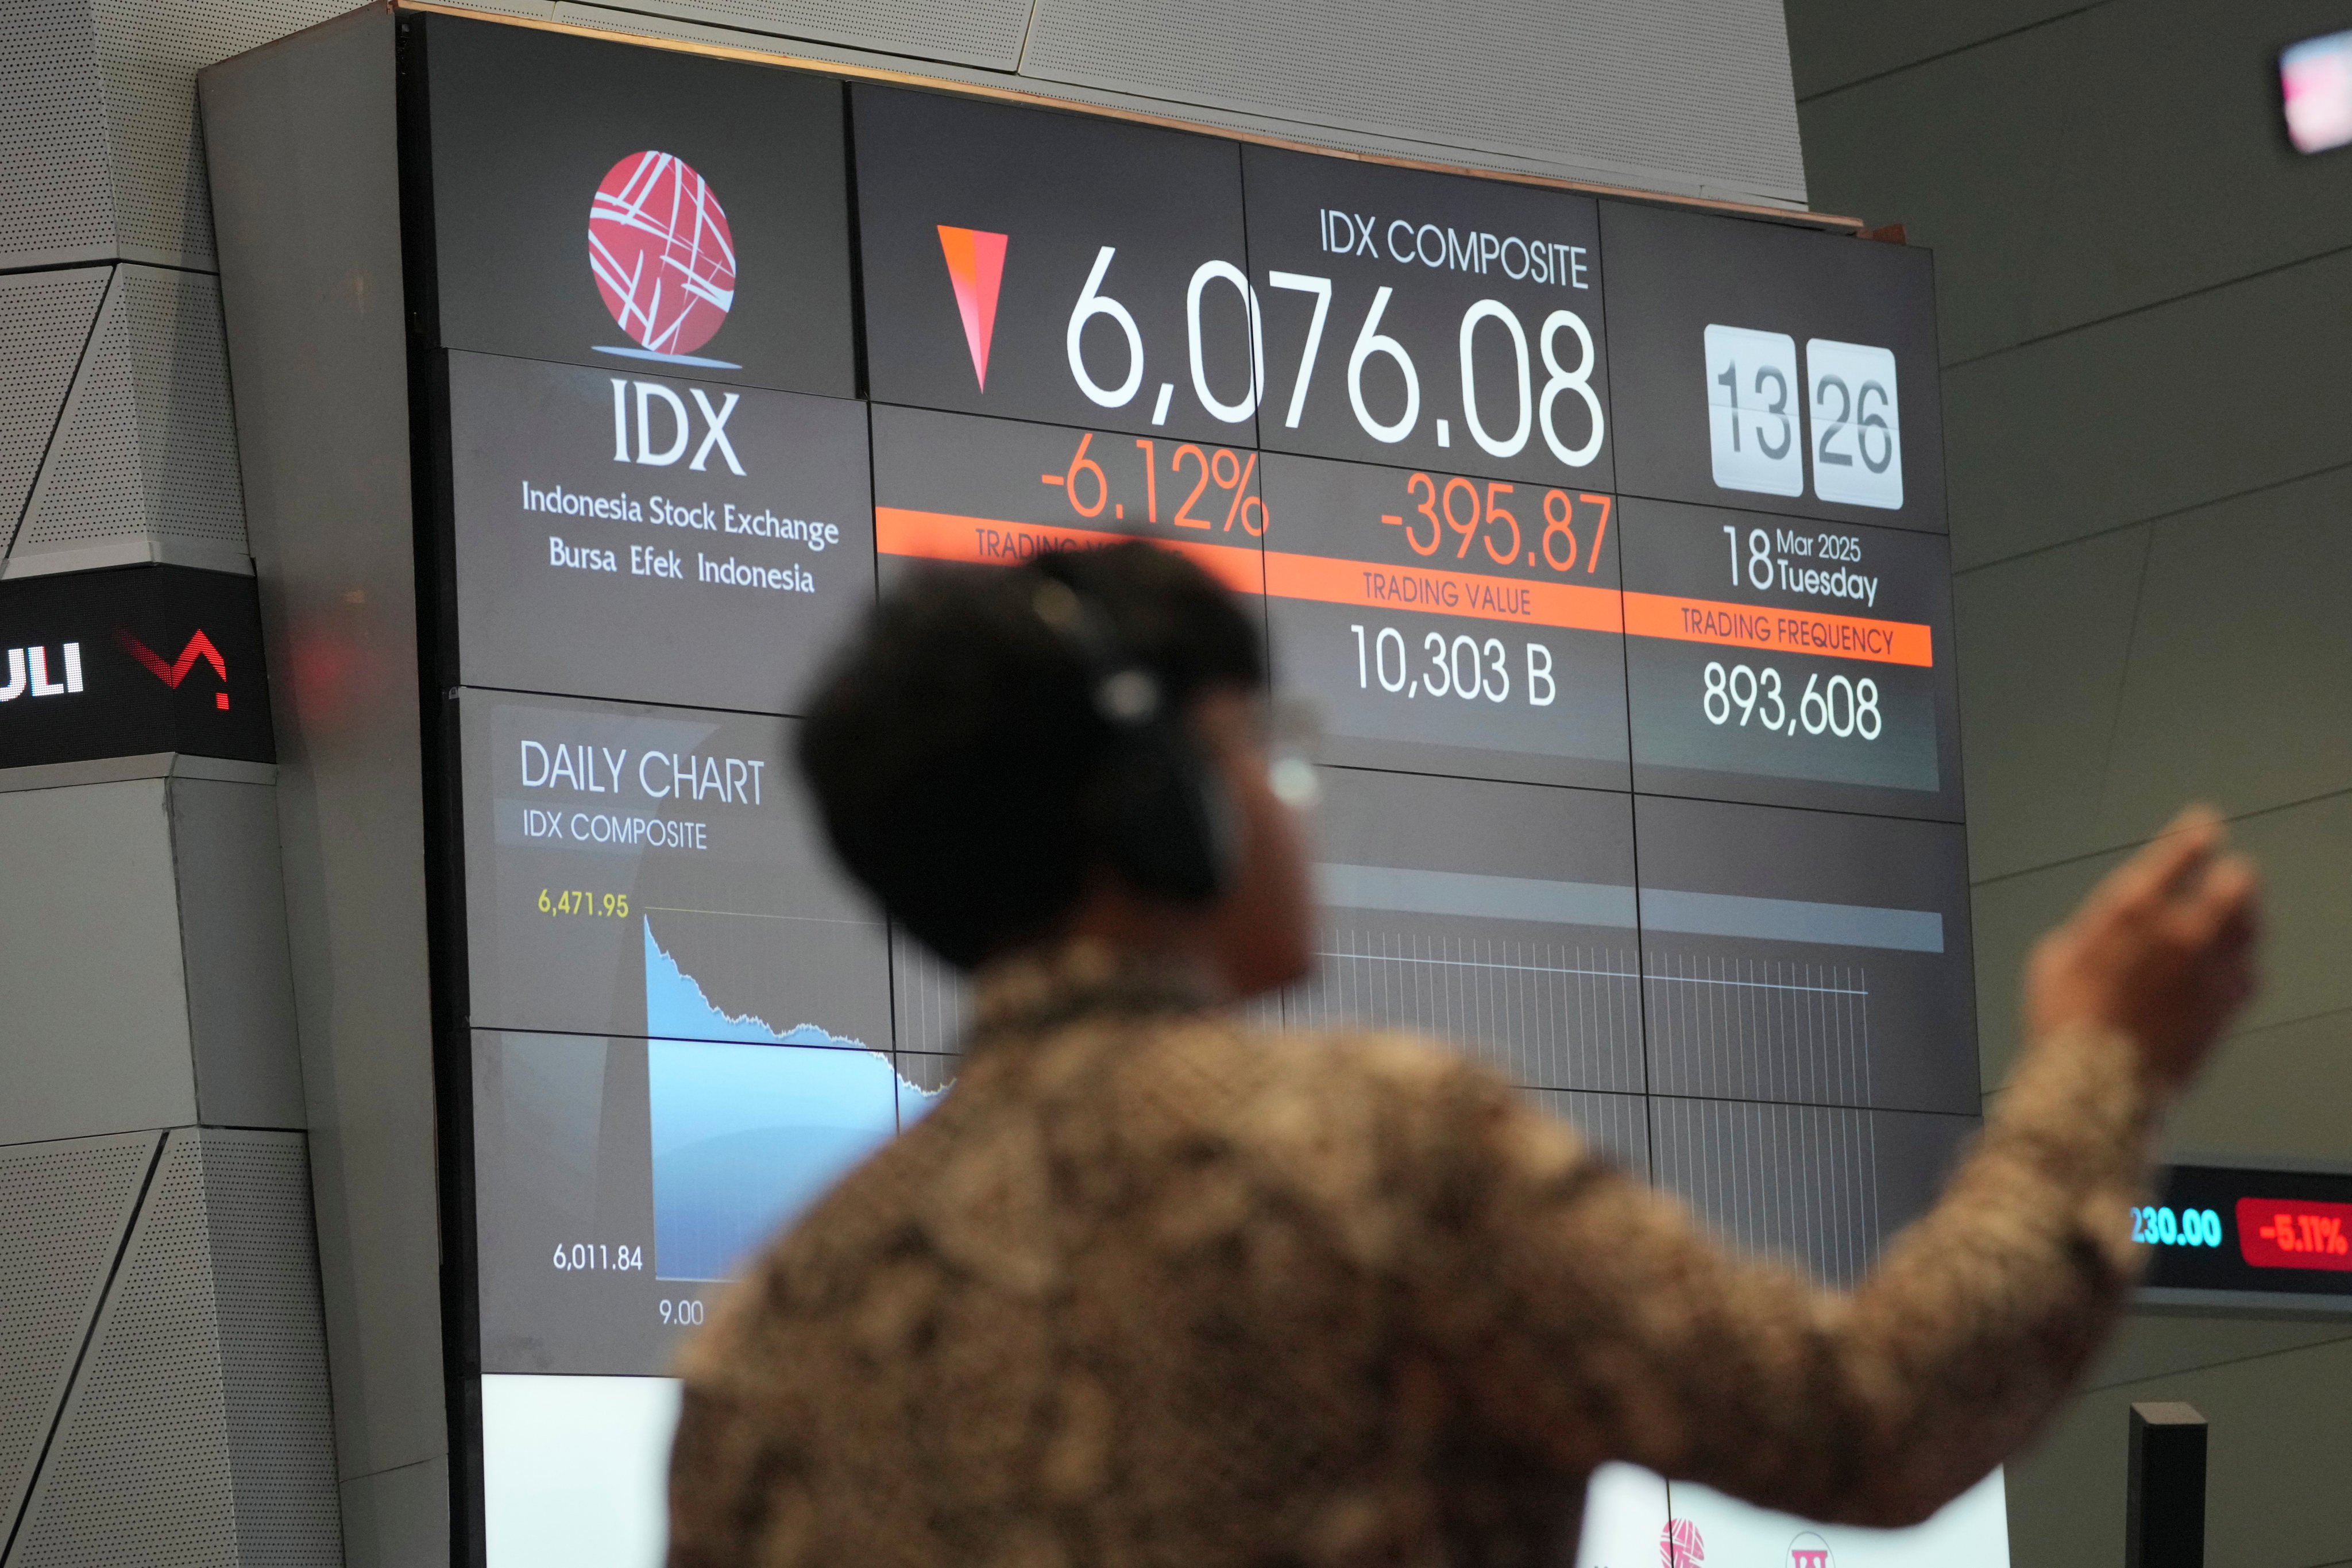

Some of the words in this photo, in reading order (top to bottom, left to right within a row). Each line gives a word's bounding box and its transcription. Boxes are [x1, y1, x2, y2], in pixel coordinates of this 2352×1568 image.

[1320, 209, 1378, 258] IDX
[1388, 220, 1588, 289] COMPOSITE
[1067, 246, 1604, 467] 6,076.08
[610, 379, 747, 476] IDX
[1718, 358, 1791, 460] 13
[1817, 374, 1892, 474] 26
[522, 481, 643, 523] Indonesia
[649, 496, 717, 531] Stock
[724, 504, 839, 551] Exchange
[1041, 433, 1269, 536] -6.12%
[1382, 473, 1611, 573] -395.87
[549, 536, 617, 571] Bursa
[630, 545, 683, 579] Efek
[698, 553, 816, 593] Indonesia
[1724, 526, 1774, 590] 18
[1776, 528, 1813, 556] Mar
[1818, 534, 1861, 562] 2025
[1777, 559, 1878, 607] Tuesday
[1363, 572, 1459, 607] TRADING
[1466, 583, 1531, 615] VALUE
[1681, 608, 1771, 642] TRADING
[1778, 619, 1894, 655] FREQUENCY
[1351, 624, 1509, 703] 10,303
[1527, 643, 1556, 706] B
[1704, 661, 1882, 740] 893,608
[521, 740, 627, 793] DAILY
[639, 750, 764, 805] CHART
[523, 809, 563, 839] IDX
[570, 813, 707, 849] COMPOSITE
[538, 889, 628, 918] 6,471.95
[553, 1243, 643, 1271] 6,011.84
[2260, 1214, 2348, 1256] -5.11%
[659, 1299, 704, 1325] 9.00
